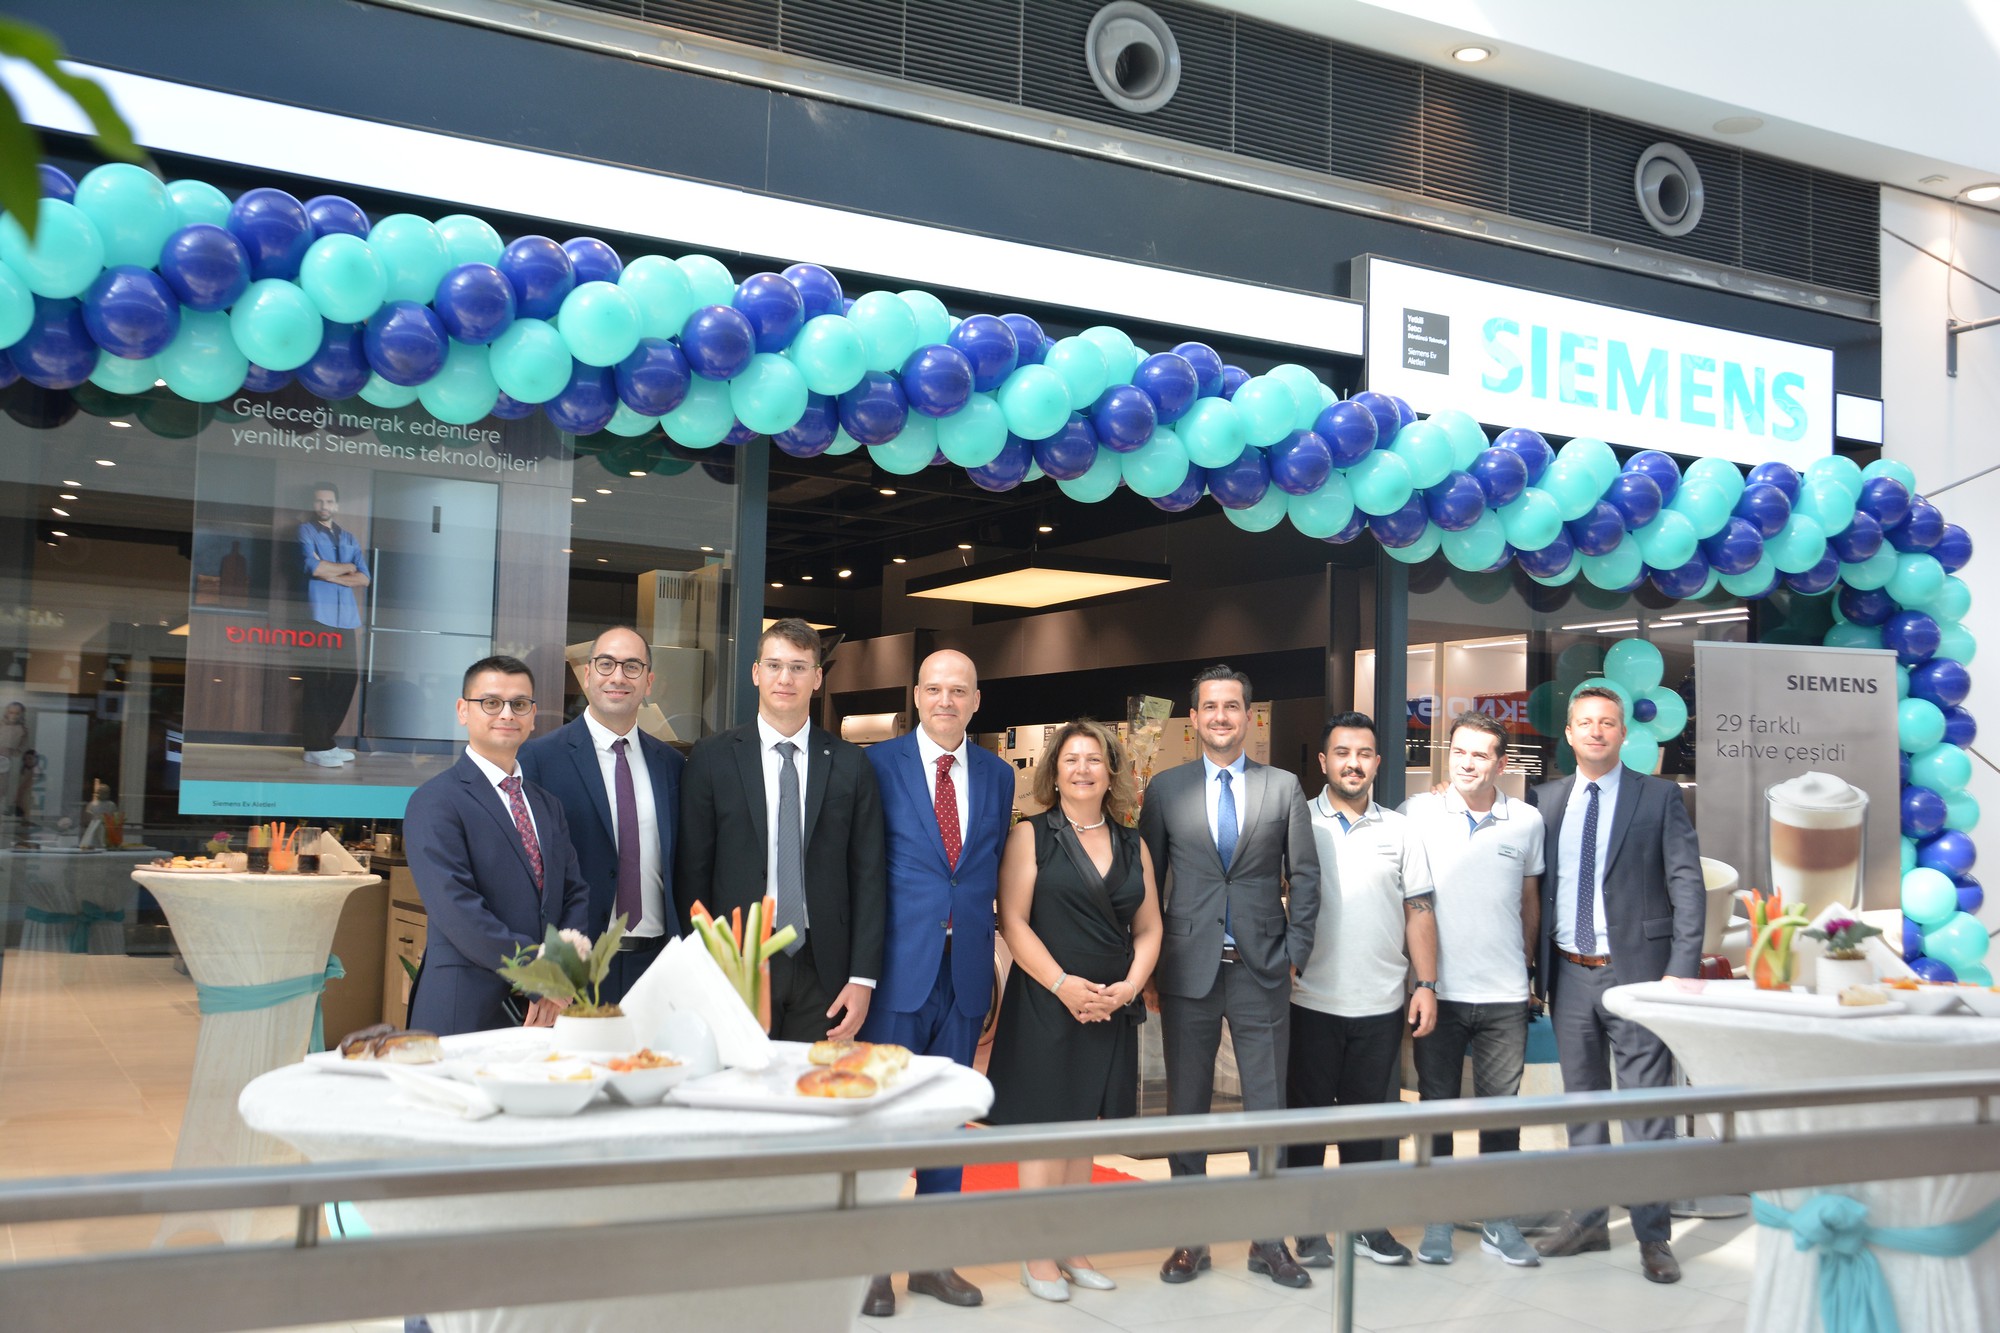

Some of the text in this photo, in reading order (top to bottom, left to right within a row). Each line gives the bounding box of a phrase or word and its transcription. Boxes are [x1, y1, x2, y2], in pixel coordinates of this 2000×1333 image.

[1407, 347, 1437, 359] Siemens Ev
[1480, 316, 1808, 443] SIEMENS
[233, 398, 501, 444] Geleceği merak edenlere
[231, 428, 538, 474] yenilikçi Siemens teknolojileri
[1786, 674, 1878, 694] SIEMENS
[1716, 713, 1800, 735] 29 farklı
[1716, 739, 1845, 764] kahve çeşidi
